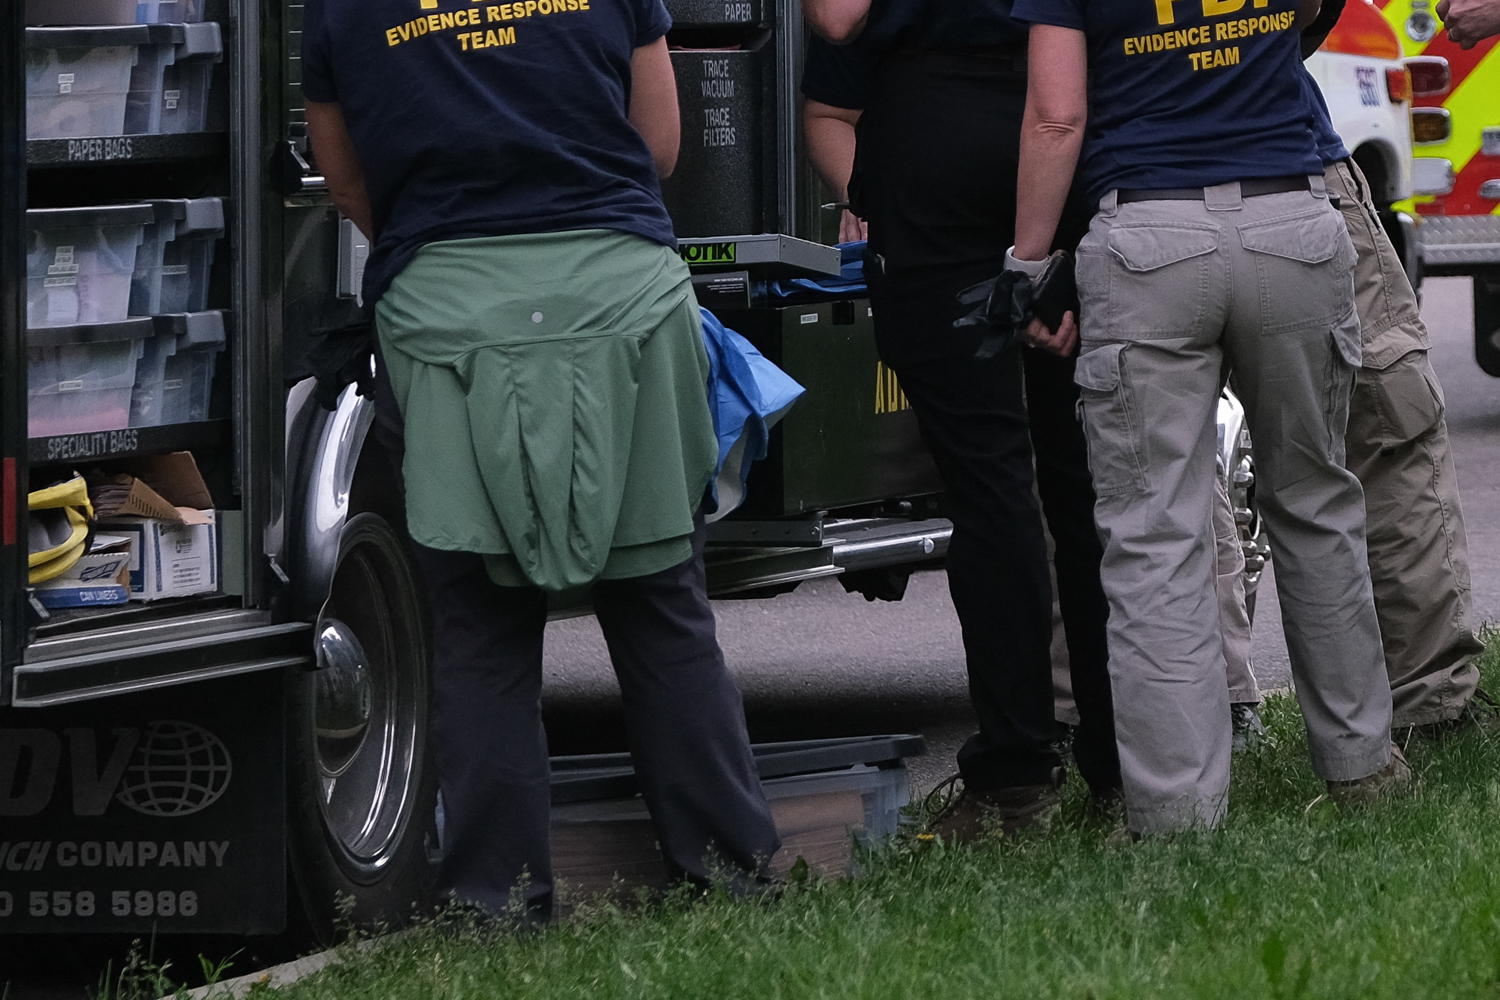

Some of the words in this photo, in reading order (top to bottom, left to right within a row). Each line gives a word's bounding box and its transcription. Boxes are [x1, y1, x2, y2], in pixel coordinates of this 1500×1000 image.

[725, 3, 752, 22] PAPER
[385, 8, 481, 47] EVIDENCE
[457, 26, 517, 51] TEAM
[1124, 25, 1211, 56] EVIDENCE
[1215, 10, 1296, 41] RESPONSE
[703, 60, 729, 78] TRACE
[1189, 46, 1240, 71] TEAM
[701, 80, 735, 99] VACUUM
[704, 108, 730, 127] TRACE
[68, 138, 103, 161] PAPER
[104, 137, 133, 160] BAGS
[703, 127, 736, 147] FILTERS
[47, 433, 107, 460] SPECIALITY
[110, 430, 138, 452] BAGS
[56, 841, 230, 867] COMPANY
[29, 890, 96, 917] 558
[111, 890, 198, 917] 5986
